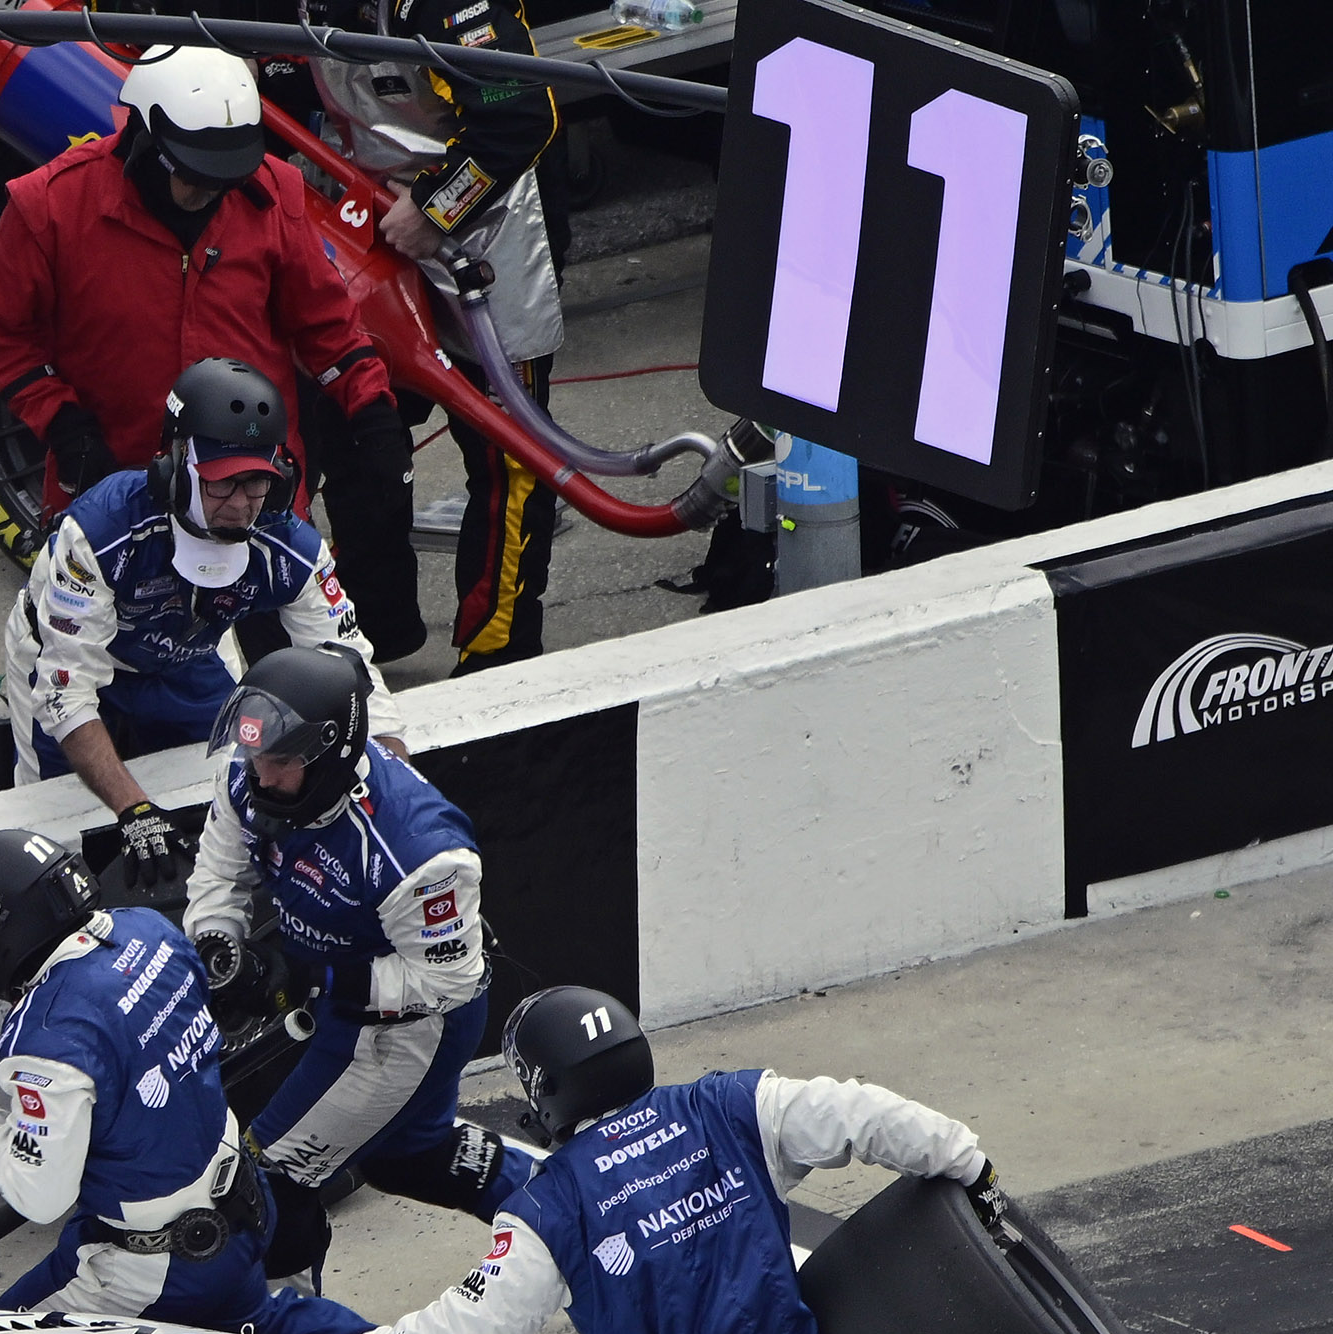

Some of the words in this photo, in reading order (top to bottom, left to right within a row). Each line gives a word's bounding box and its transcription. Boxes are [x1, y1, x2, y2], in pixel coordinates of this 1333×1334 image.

[752, 36, 1029, 466] 11
[347, 692, 356, 740] NATIONAL
[24, 835, 55, 864] 11
[313, 842, 351, 885] TOYOTA
[421, 924, 453, 939] Mobil
[112, 938, 145, 973] TOYOTA
[427, 950, 468, 964] TOOLS
[117, 940, 175, 1016] BOUAGNON
[137, 971, 196, 1050] joegibbsracing.com
[580, 1006, 612, 1042] 11
[165, 1003, 215, 1072] NATION
[598, 1106, 659, 1138] TOYOTA
[594, 1121, 688, 1174] DOWELL
[637, 1170, 745, 1238] NATIONAL
[671, 1222, 698, 1245] DEBT
[698, 1203, 735, 1232] RELIEF
